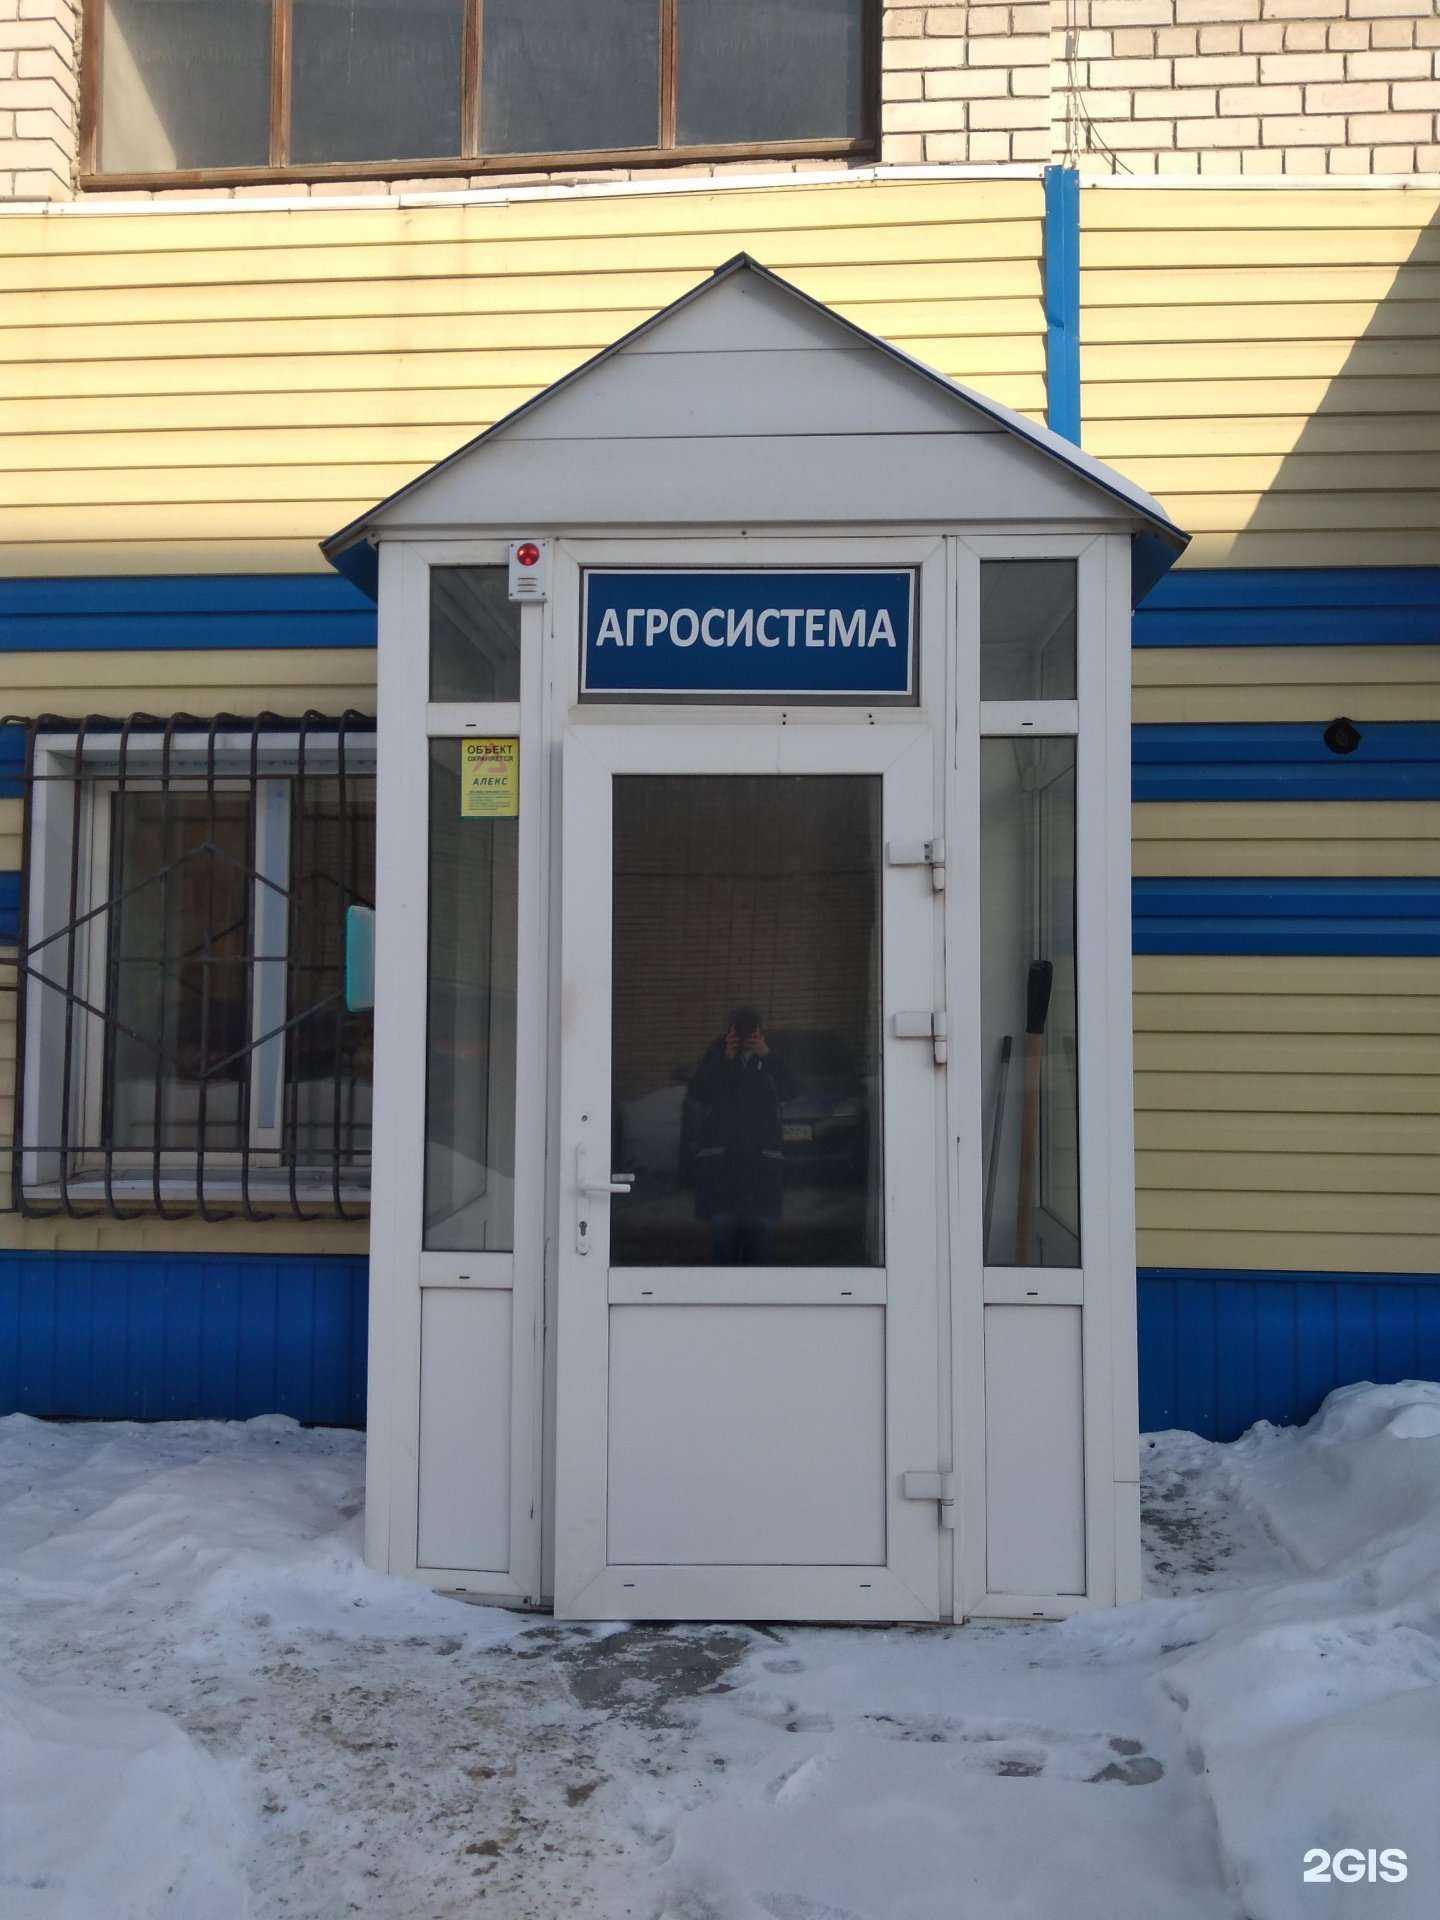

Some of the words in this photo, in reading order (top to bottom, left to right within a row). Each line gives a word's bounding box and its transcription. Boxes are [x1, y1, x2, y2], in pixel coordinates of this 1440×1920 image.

[595, 608, 897, 648] АГРОСИСТЕМА
[467, 745, 512, 754] ОБЪЕКТ
[473, 777, 509, 786] АЛЕКС
